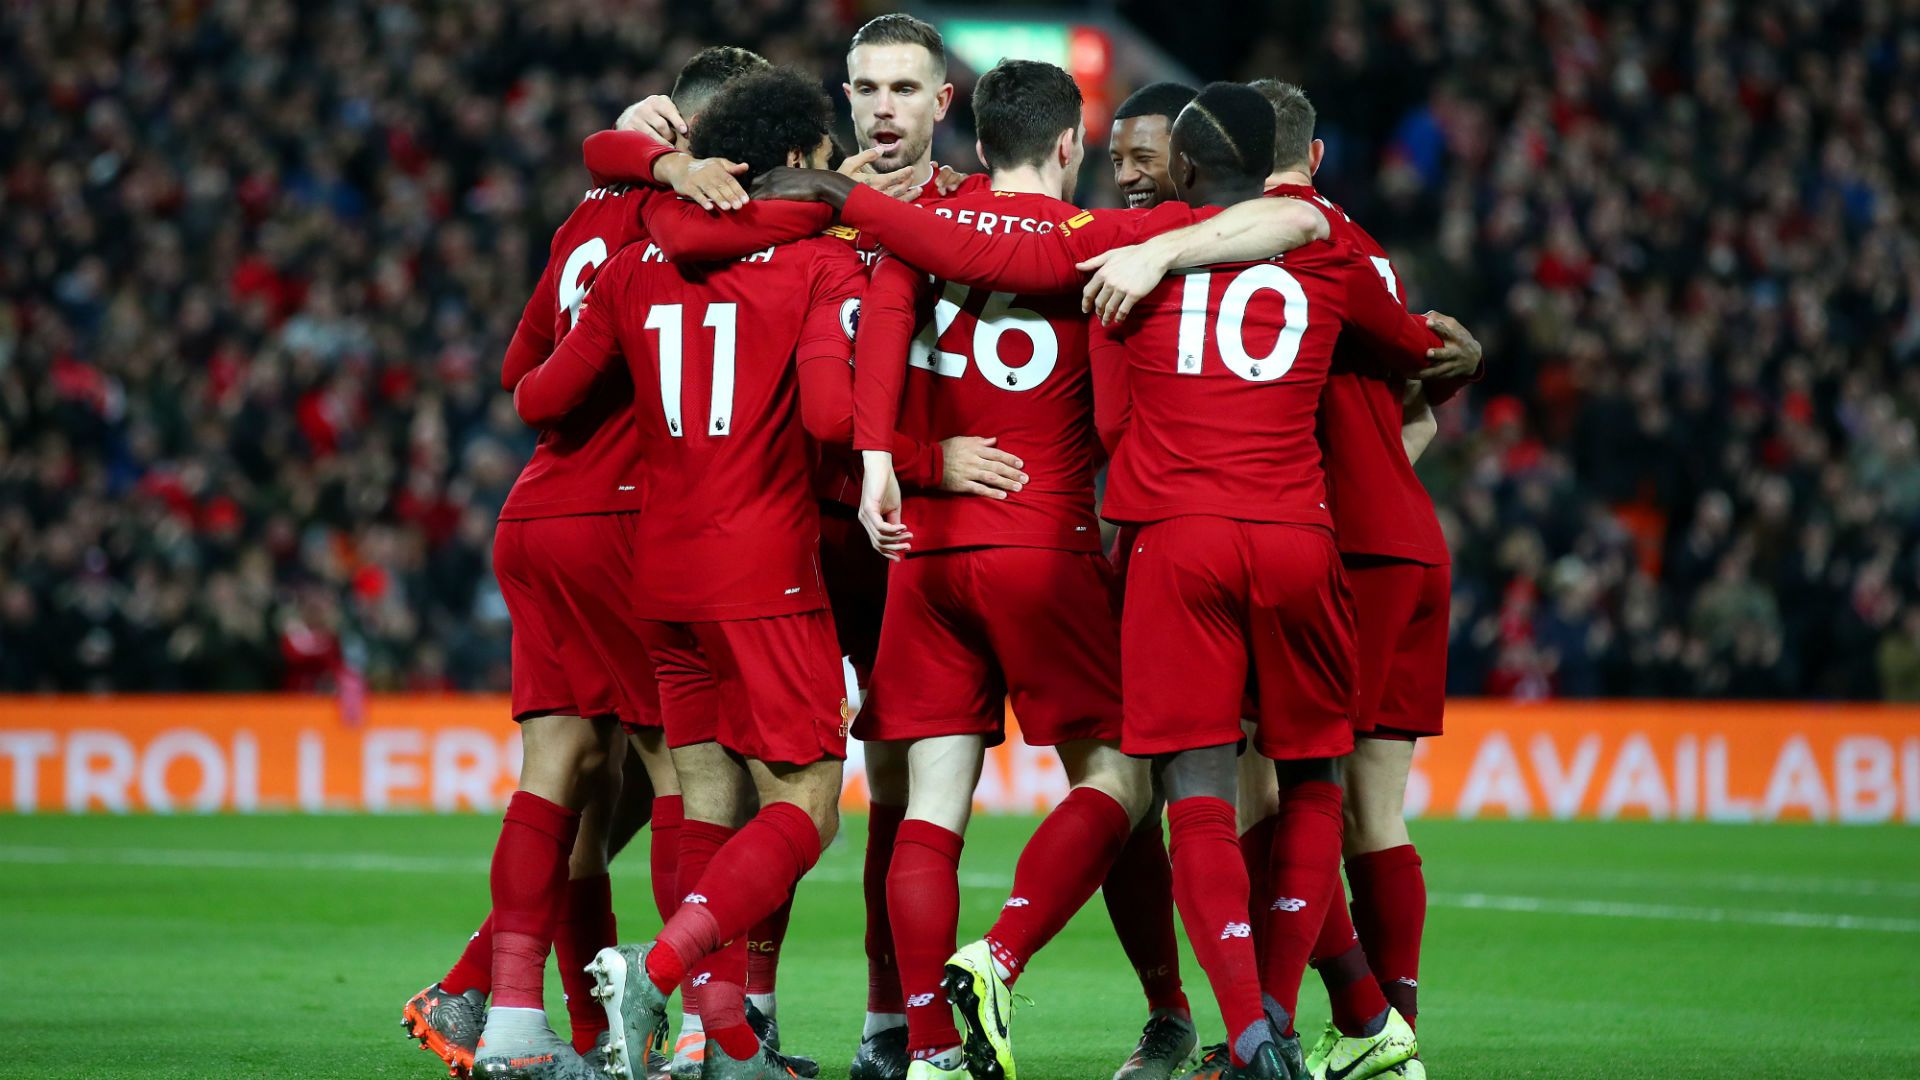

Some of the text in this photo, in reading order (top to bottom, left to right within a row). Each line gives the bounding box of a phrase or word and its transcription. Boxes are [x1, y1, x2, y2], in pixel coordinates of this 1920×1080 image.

[643, 302, 737, 437] 11
[909, 273, 1058, 391] 26
[1169, 263, 1308, 382] 10
[0, 730, 523, 814] TROLLER
